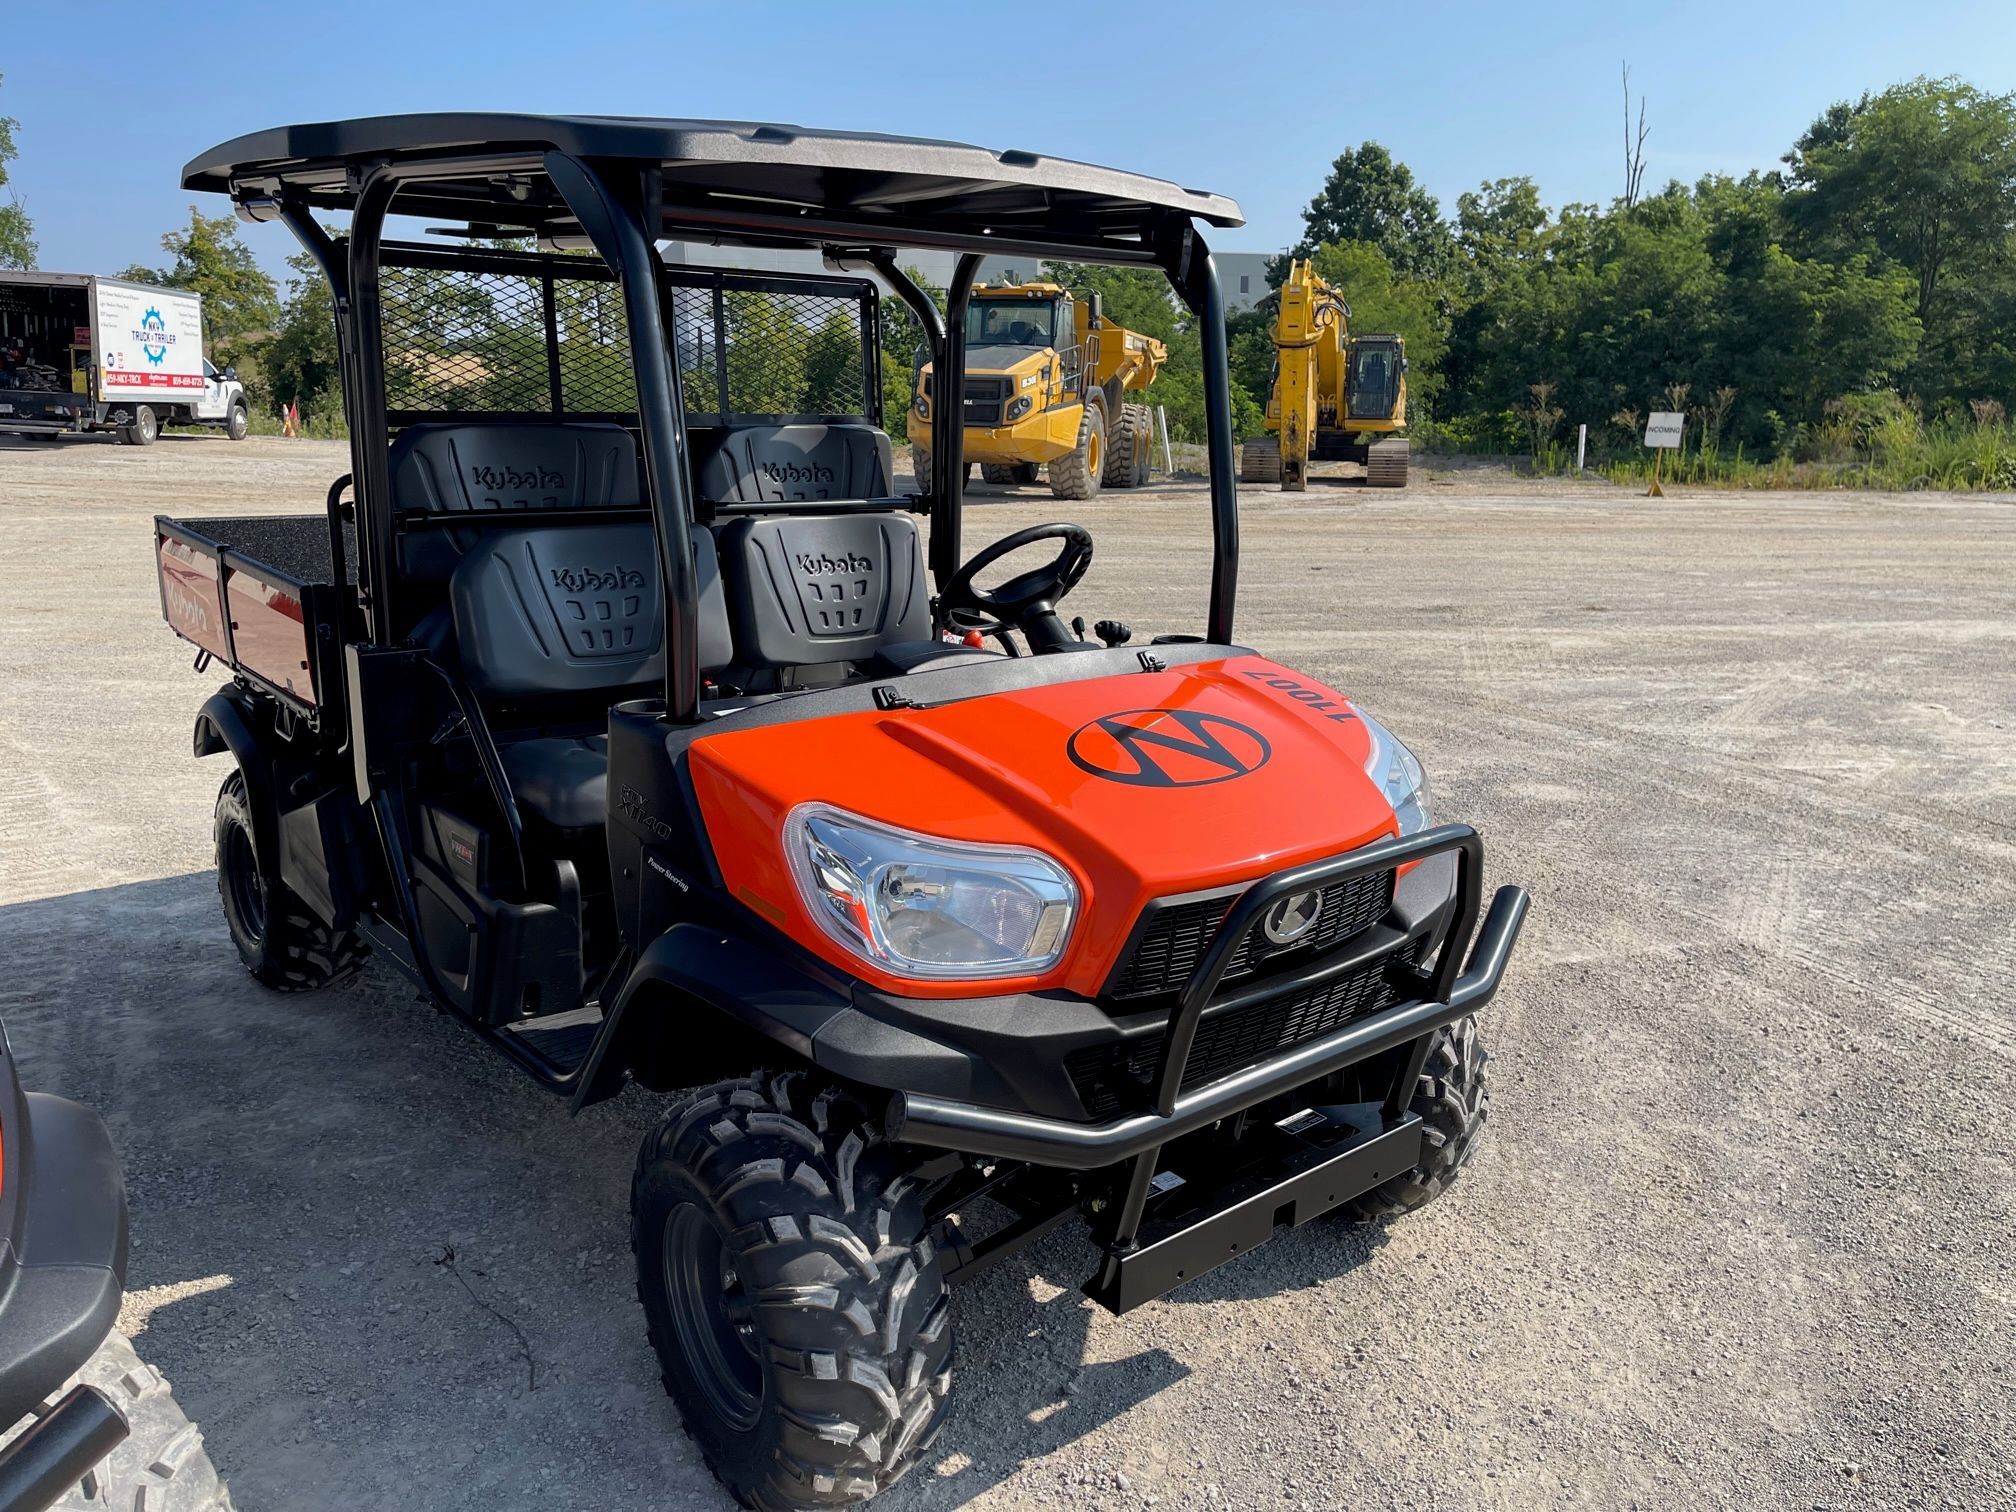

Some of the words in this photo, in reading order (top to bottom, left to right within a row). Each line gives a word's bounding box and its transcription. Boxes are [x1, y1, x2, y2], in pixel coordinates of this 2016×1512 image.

[132, 330, 151, 341] TRUCK
[154, 332, 176, 345] TRAILER
[1648, 425, 1681, 434] INCOMING
[470, 464, 566, 491] Kubota
[761, 461, 836, 486] Kubota
[795, 551, 873, 575] Kubota
[550, 564, 646, 592] Kubota
[1242, 671, 1357, 723] 11007
[647, 856, 666, 874] Power
[664, 869, 689, 893] Steering
